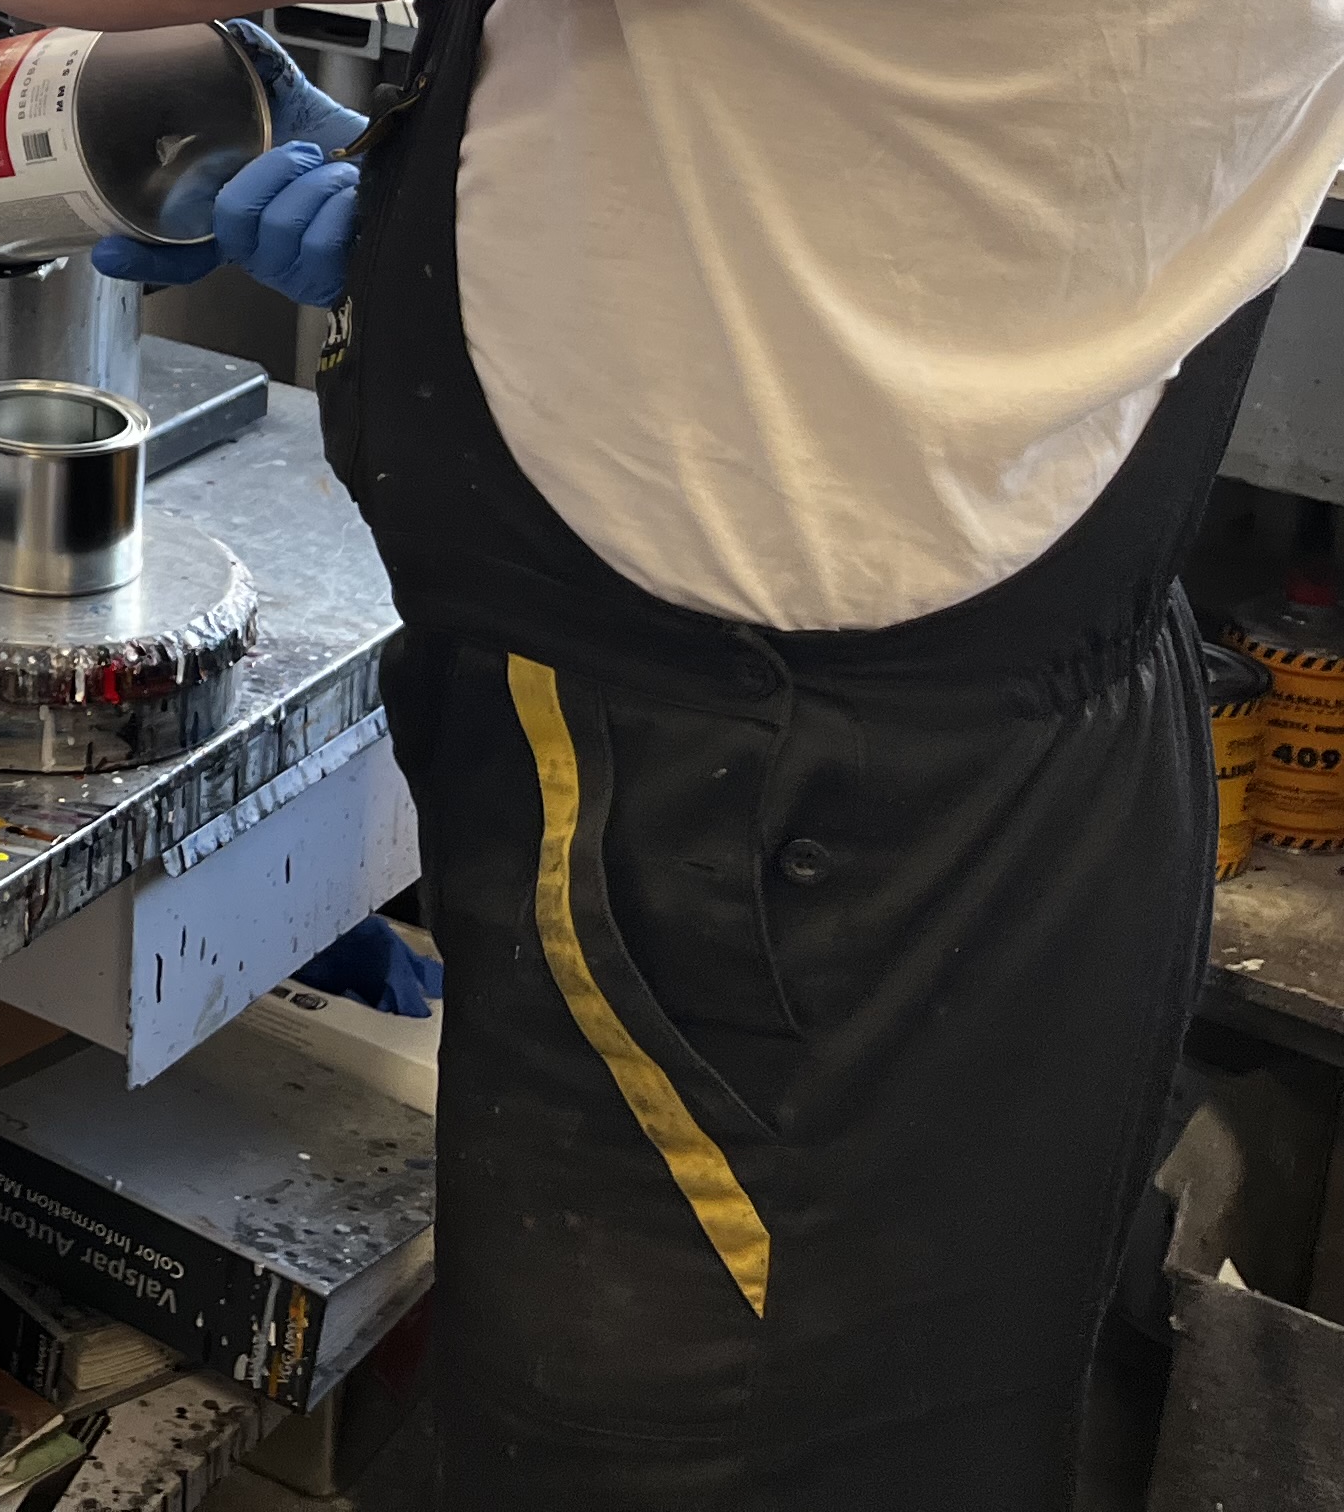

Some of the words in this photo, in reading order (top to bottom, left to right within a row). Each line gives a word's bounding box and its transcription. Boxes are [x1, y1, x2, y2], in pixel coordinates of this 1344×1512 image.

[24, 1189, 132, 1256] Information
[79, 1245, 179, 1315] Valspar
[135, 1243, 186, 1281] Color
